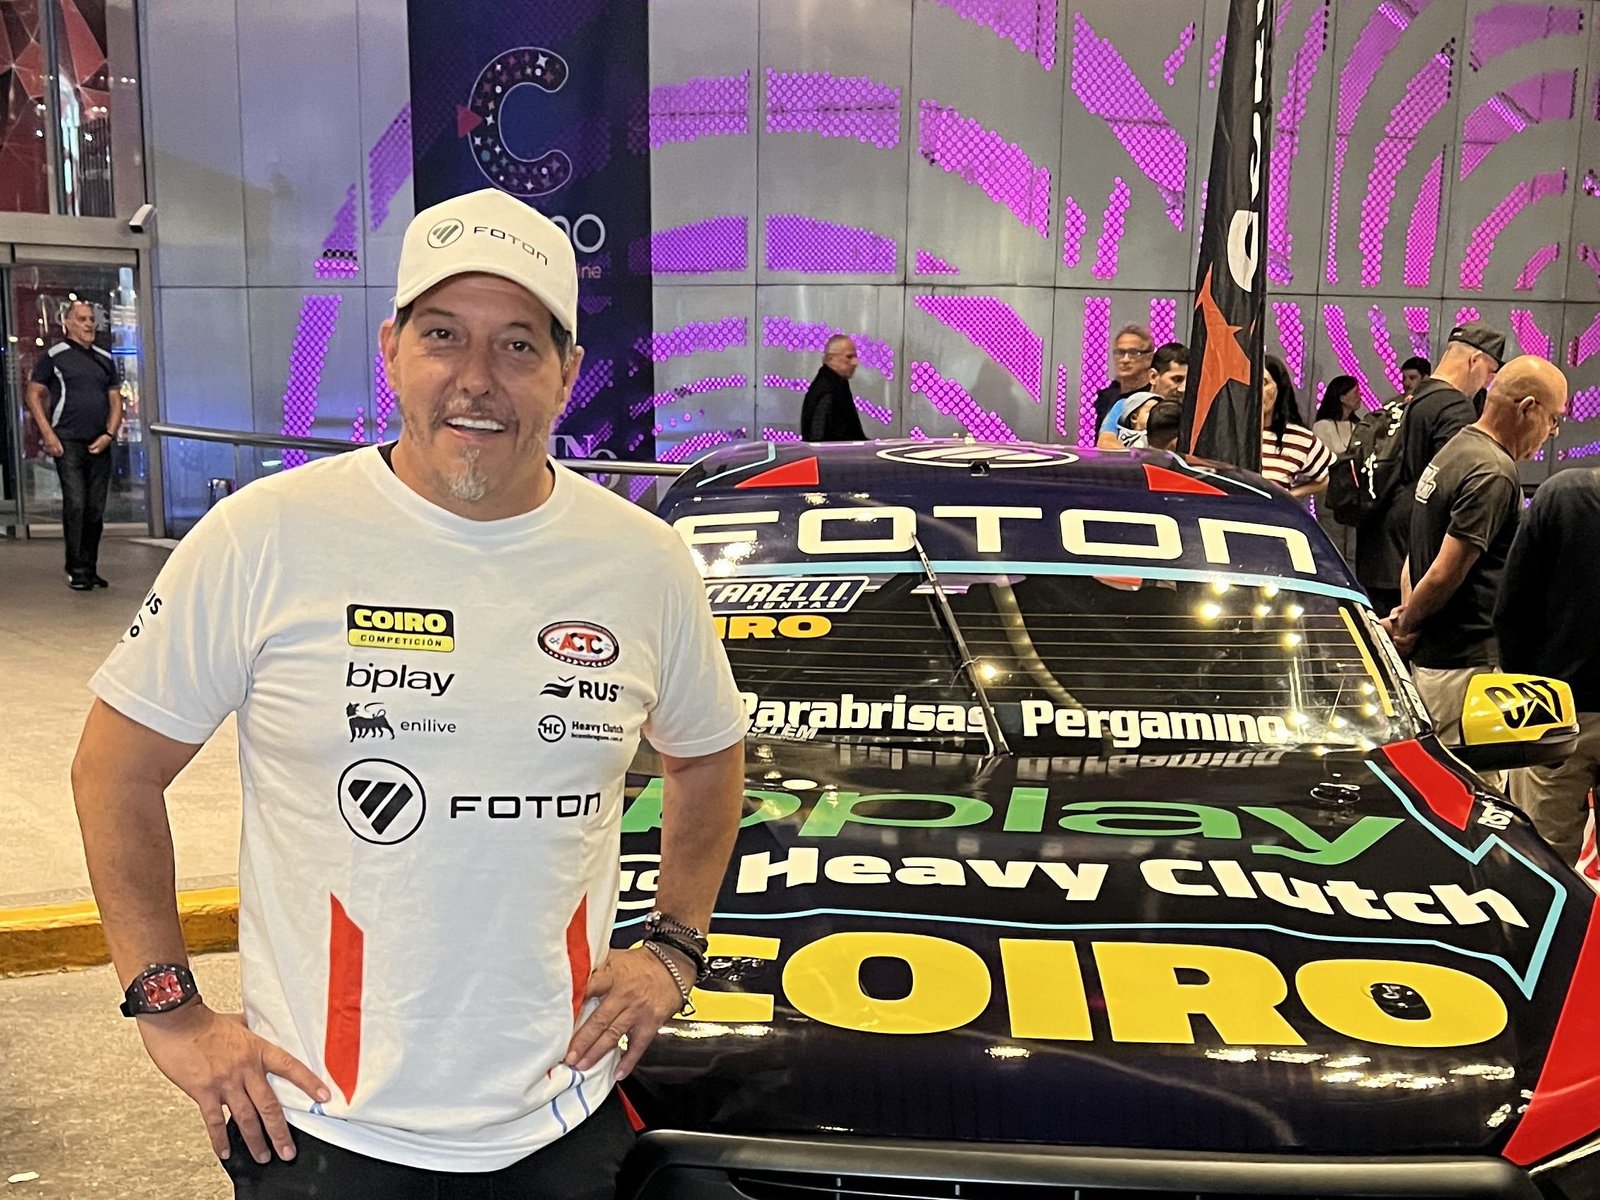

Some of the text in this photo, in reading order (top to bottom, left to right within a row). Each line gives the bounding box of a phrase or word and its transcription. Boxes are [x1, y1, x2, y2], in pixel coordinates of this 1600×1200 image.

[746, 601, 837, 610] JUNTAS
[354, 608, 447, 633] COIRO
[360, 633, 442, 647] COMPETICIÓN
[578, 680, 619, 702] RUS
[1484, 680, 1564, 729] CAT
[400, 719, 457, 733] enilive
[543, 723, 561, 734] HC
[572, 721, 600, 734] Heavy
[1020, 699, 1291, 748] Pergamino
[735, 846, 1530, 929] Heavy Clutch
